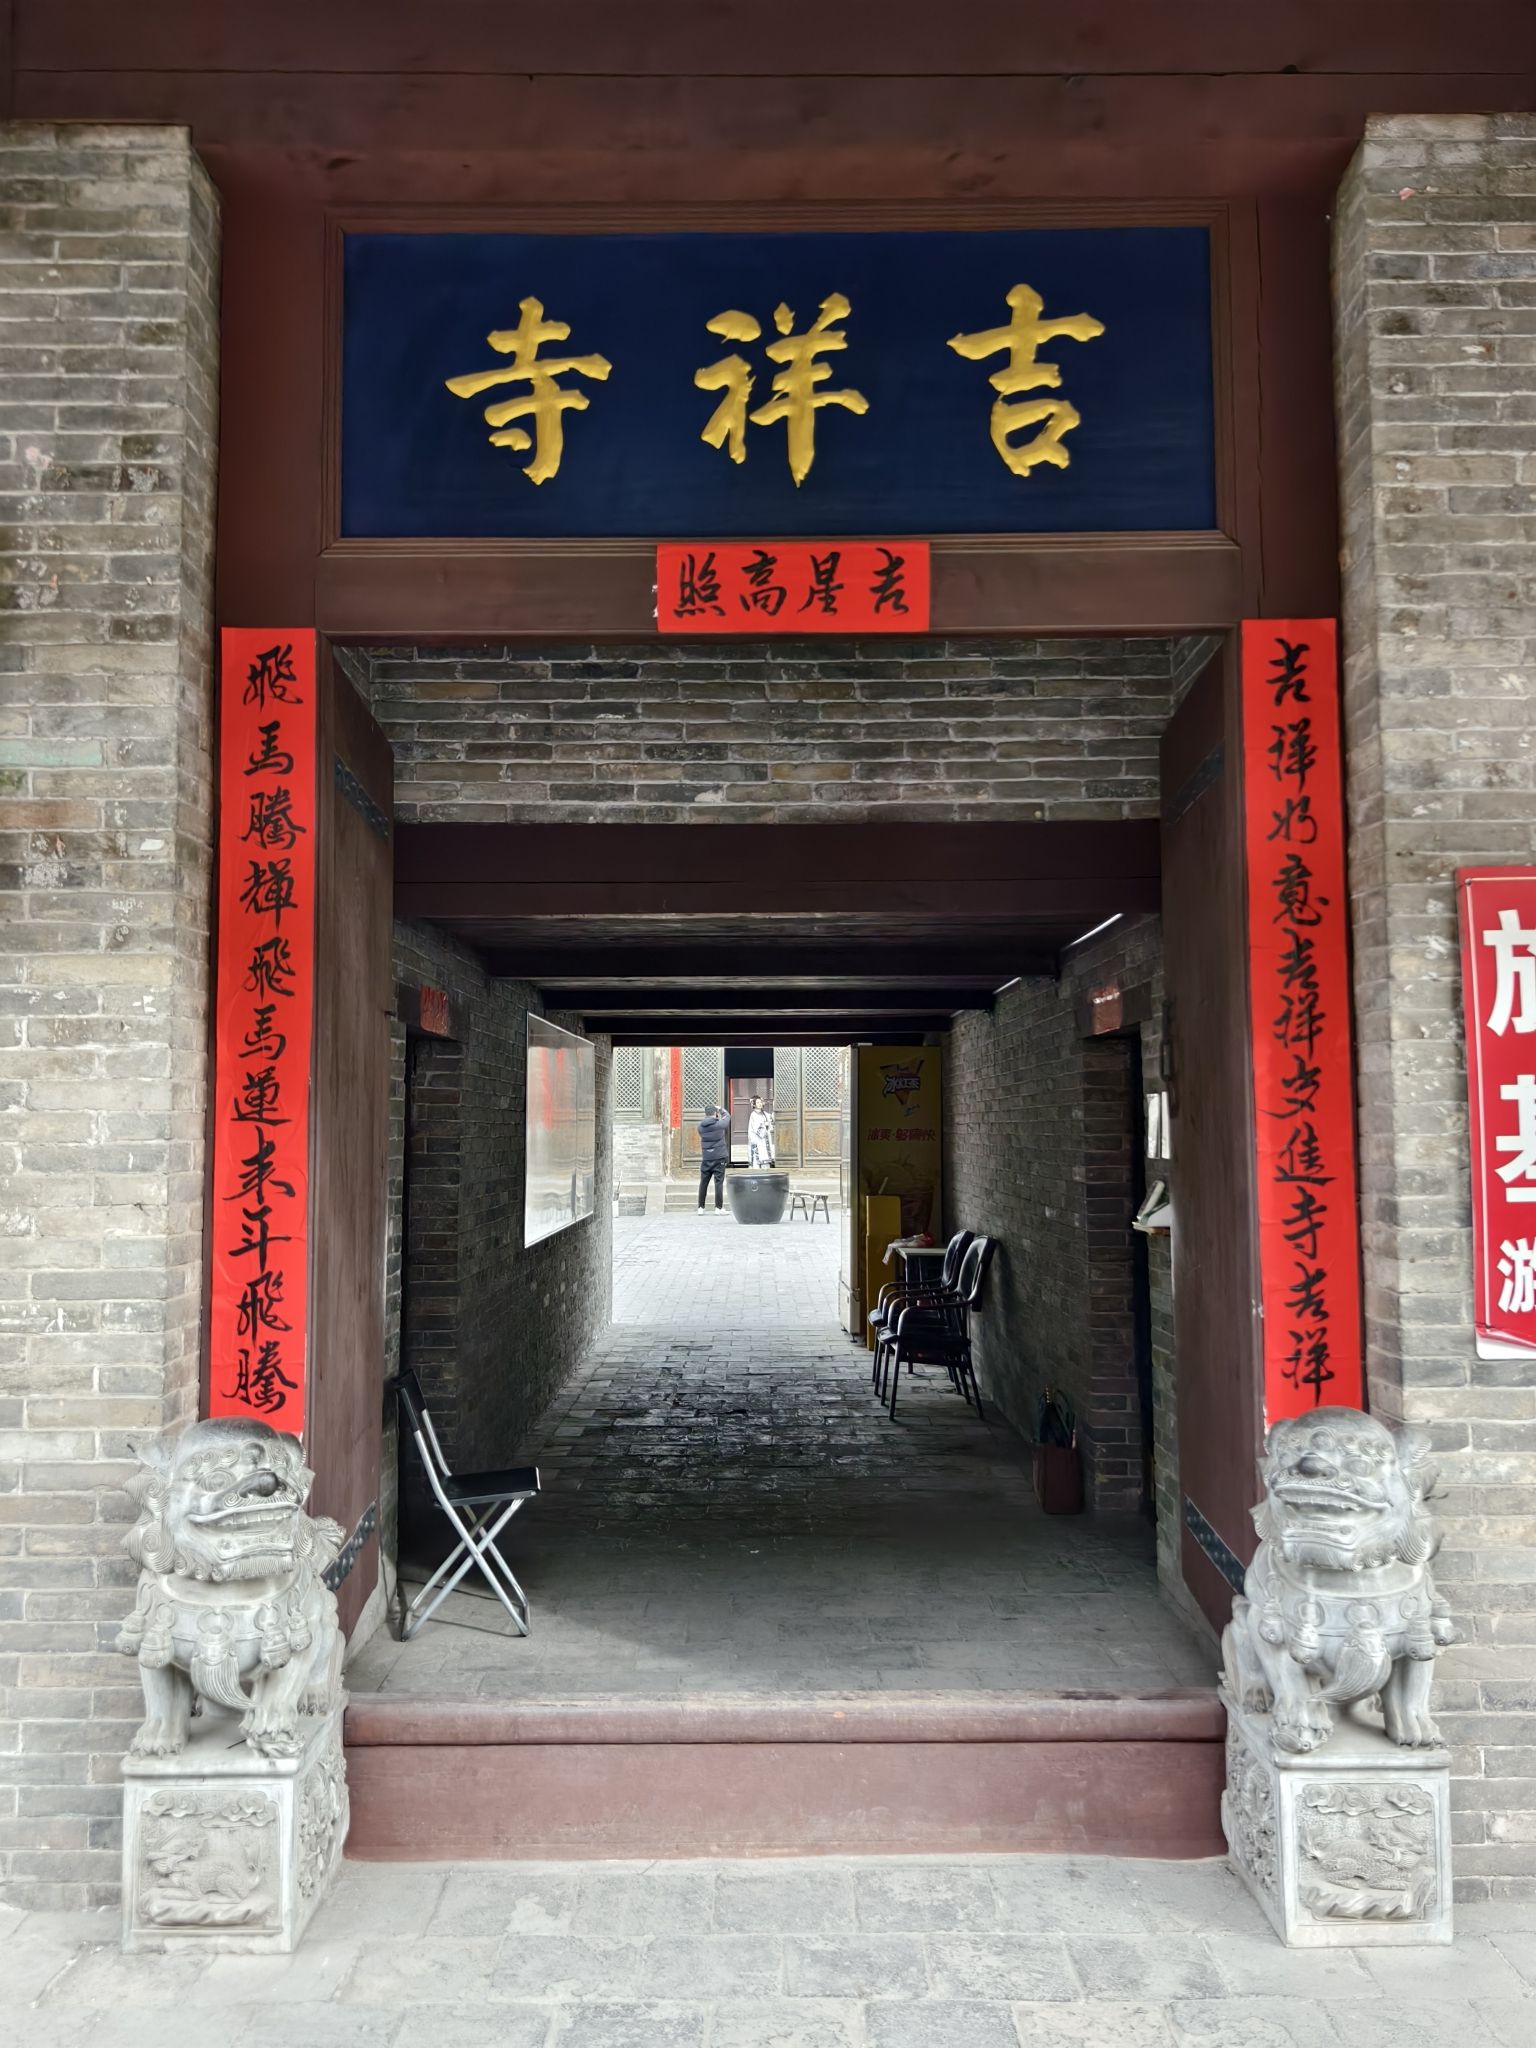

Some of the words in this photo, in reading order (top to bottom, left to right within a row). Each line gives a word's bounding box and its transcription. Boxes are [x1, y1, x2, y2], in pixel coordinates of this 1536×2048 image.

[446, 284, 1105, 487] 吉祥寺
[673, 547, 910, 618] 吉星高照
